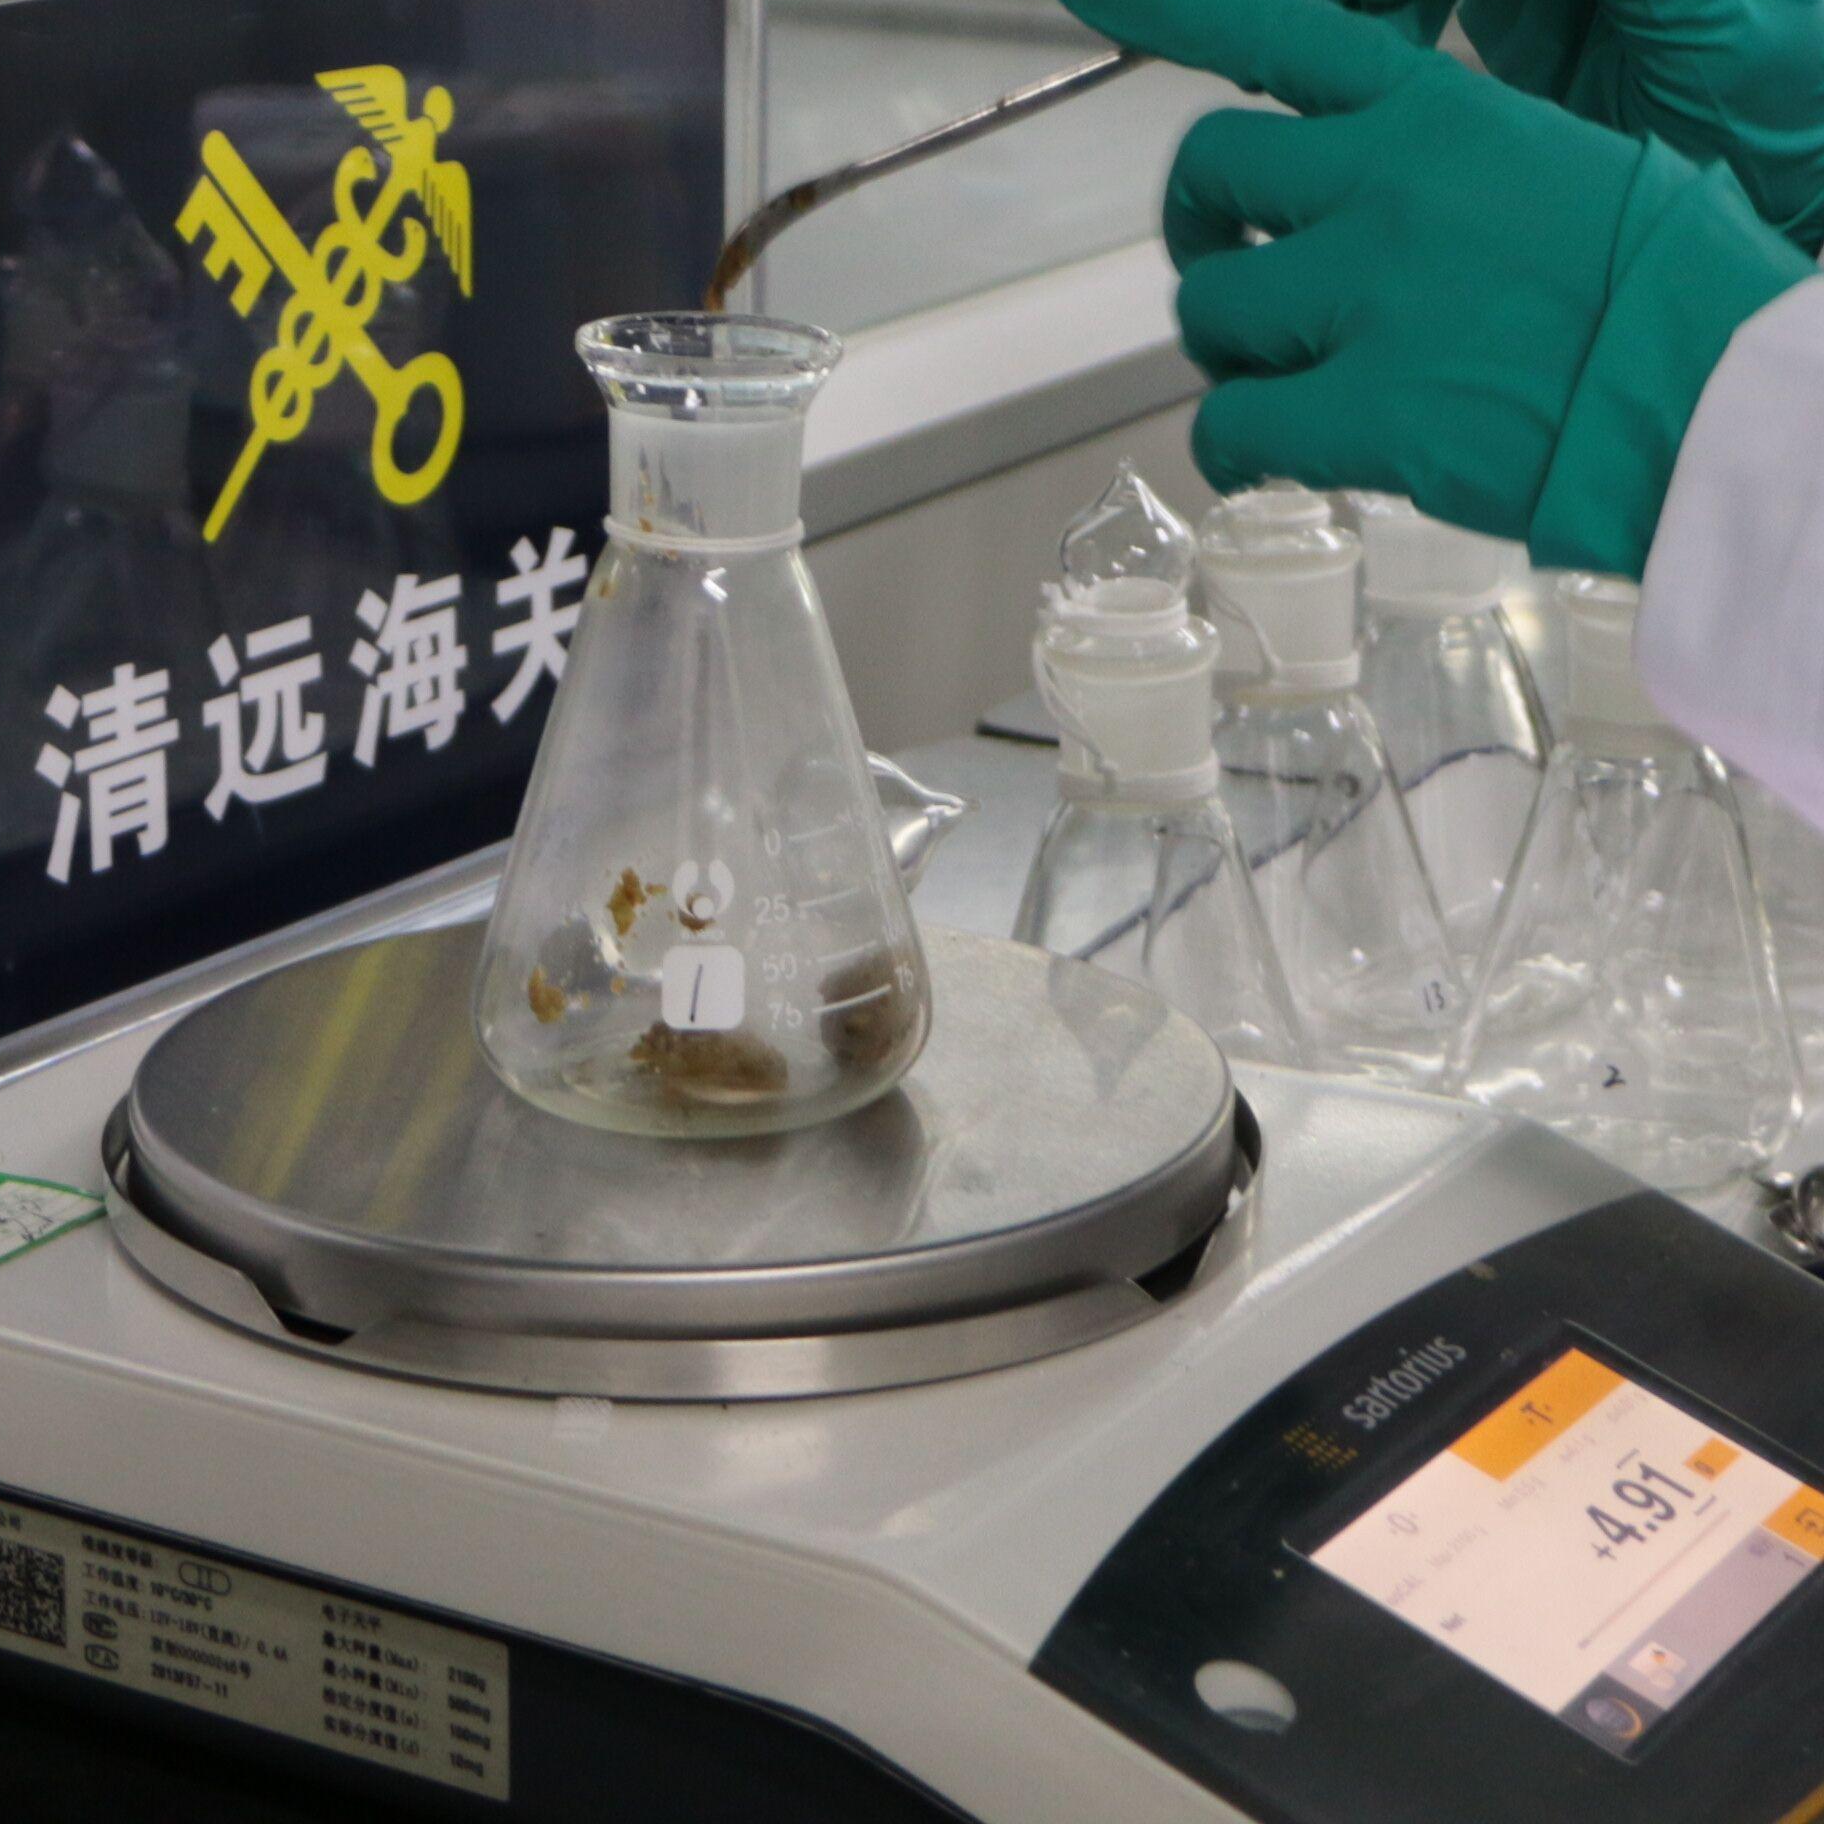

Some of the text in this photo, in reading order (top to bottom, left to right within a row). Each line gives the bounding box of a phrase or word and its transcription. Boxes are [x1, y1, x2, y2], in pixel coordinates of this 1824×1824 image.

[34, 526, 589, 886] 清远海关
[1342, 1335, 1468, 1431] sartorius
